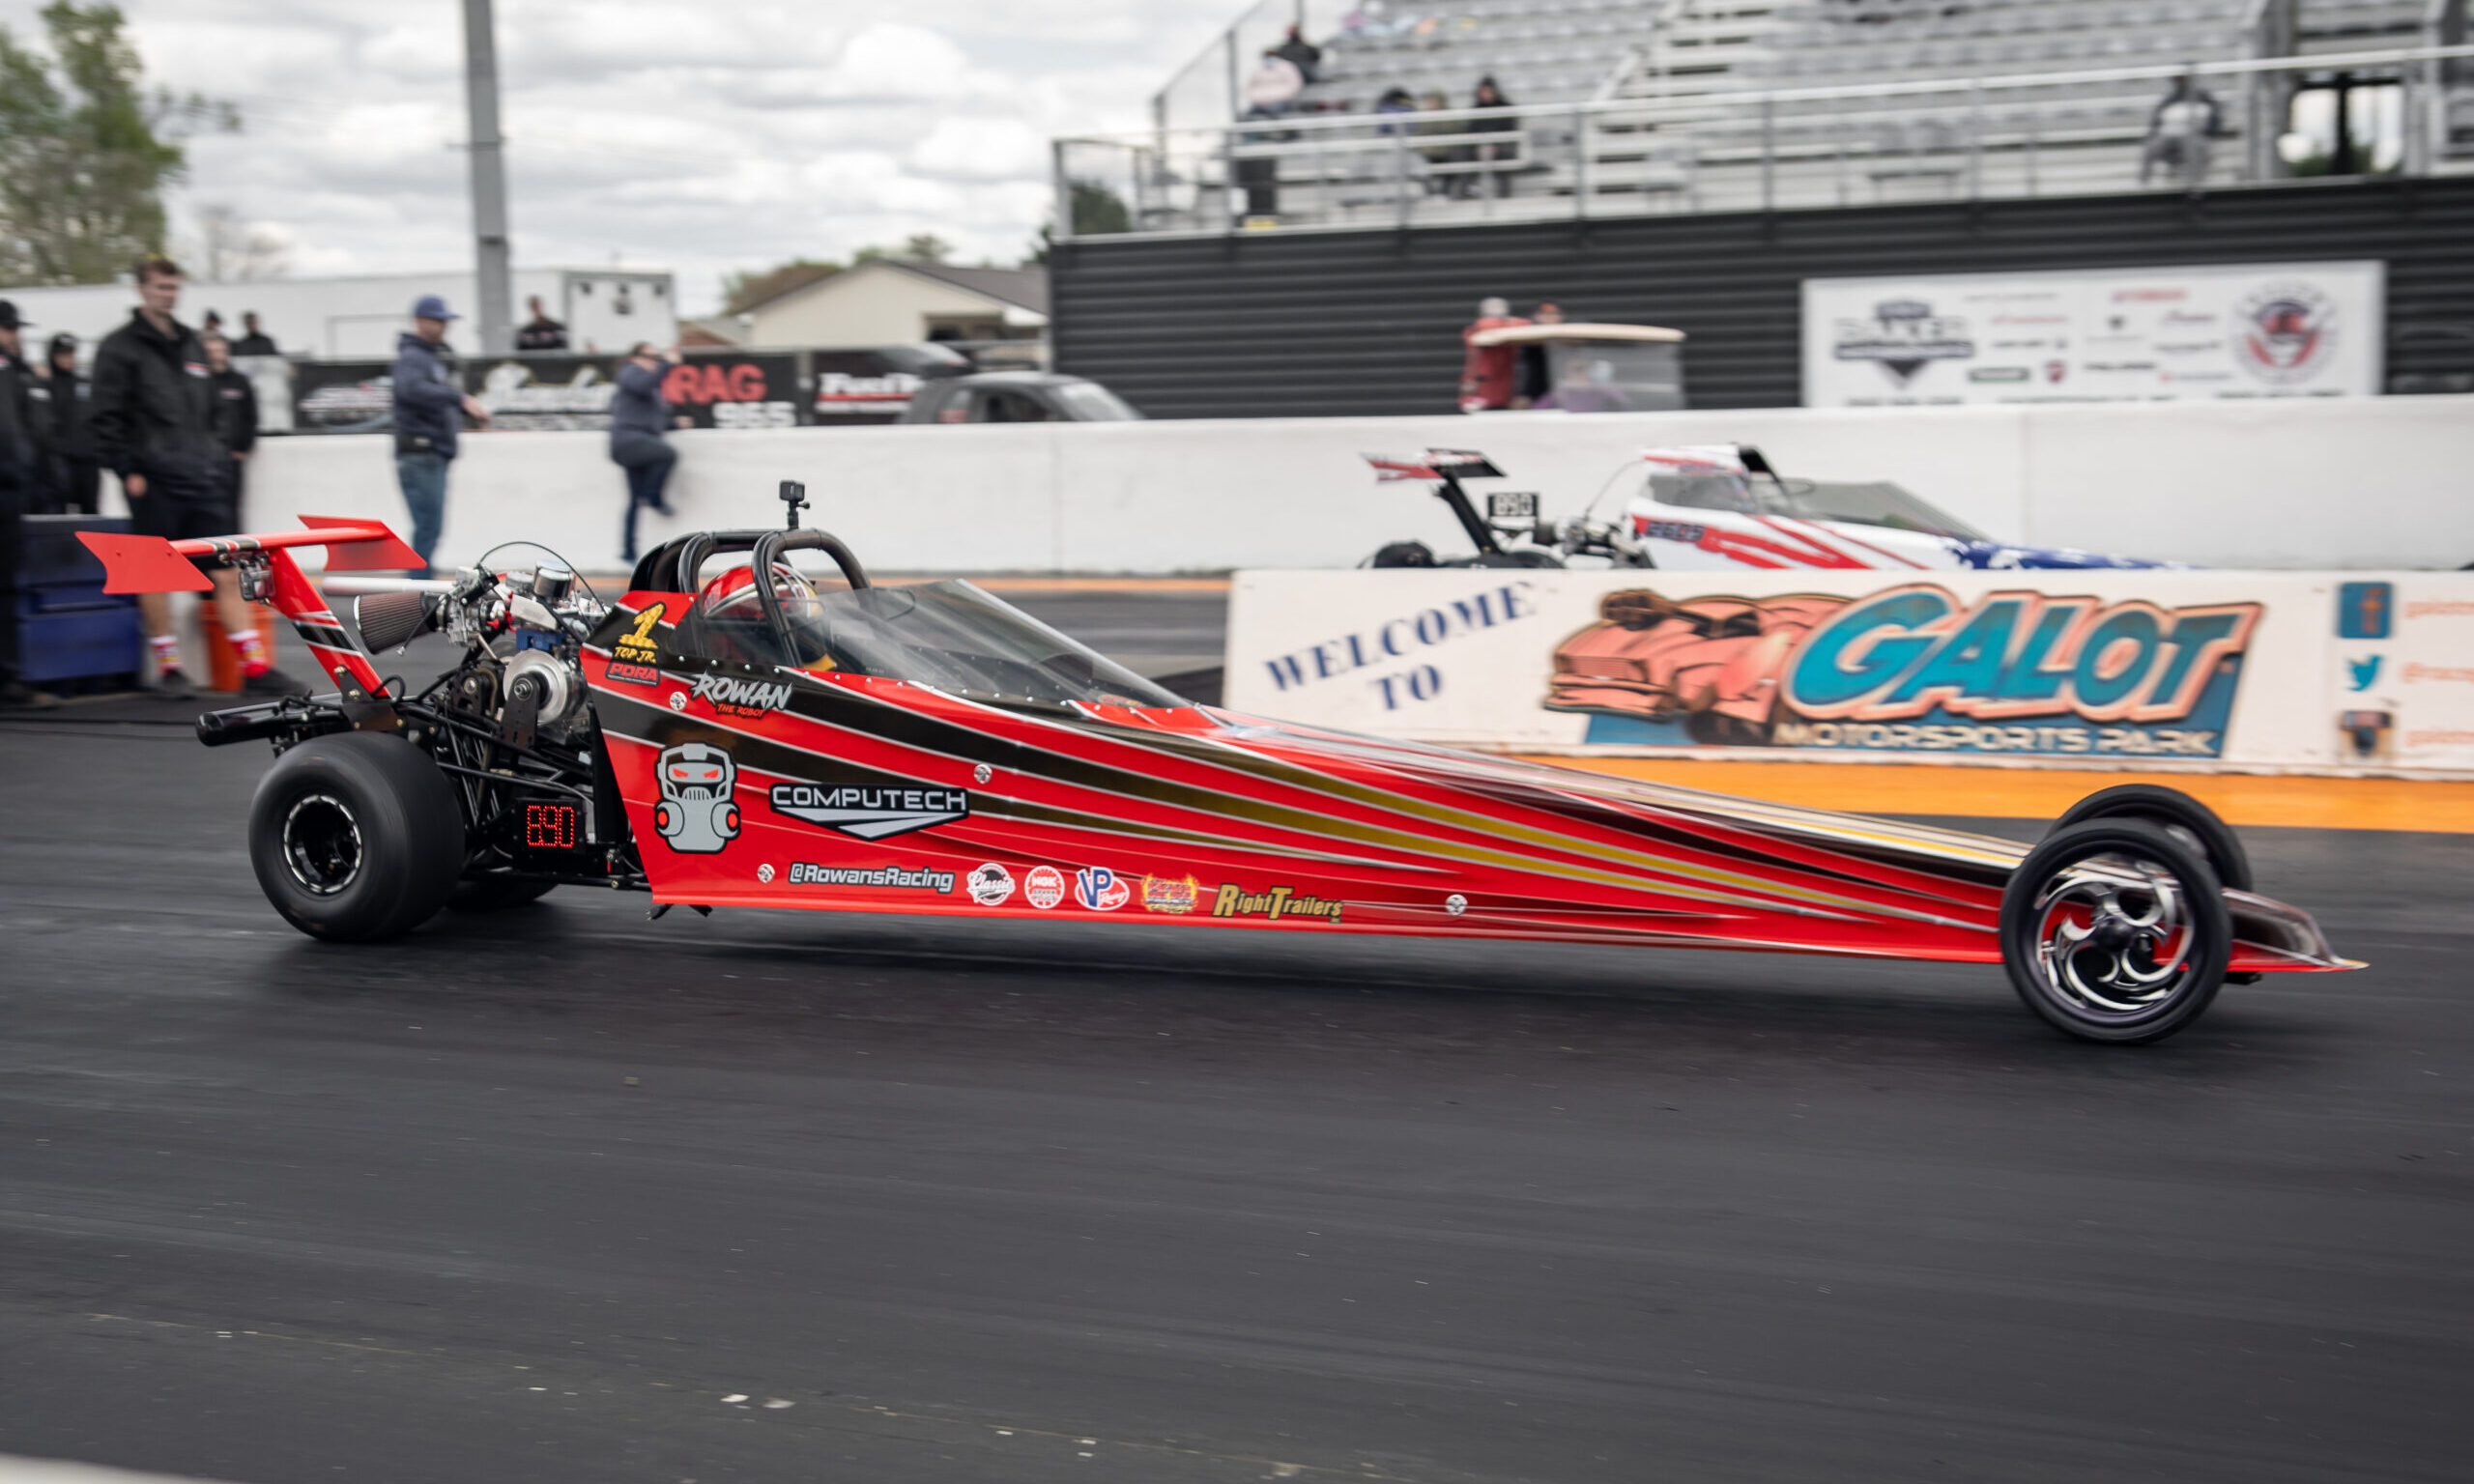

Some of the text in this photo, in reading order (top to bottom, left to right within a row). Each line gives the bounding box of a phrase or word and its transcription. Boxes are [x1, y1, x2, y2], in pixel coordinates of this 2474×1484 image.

[615, 646, 638, 659] TOP
[1263, 580, 1537, 691] WELCOME
[1788, 586, 2257, 718] GALOT
[691, 669, 792, 710] ROWAN
[1368, 663, 1442, 711] TO
[717, 702, 764, 718] THE ROBOT
[1772, 722, 2221, 756] MOTORSPORTS PARK
[772, 785, 966, 811] COMPUTECH
[790, 863, 955, 893] @RowansRacing
[1077, 867, 1113, 908] VP
